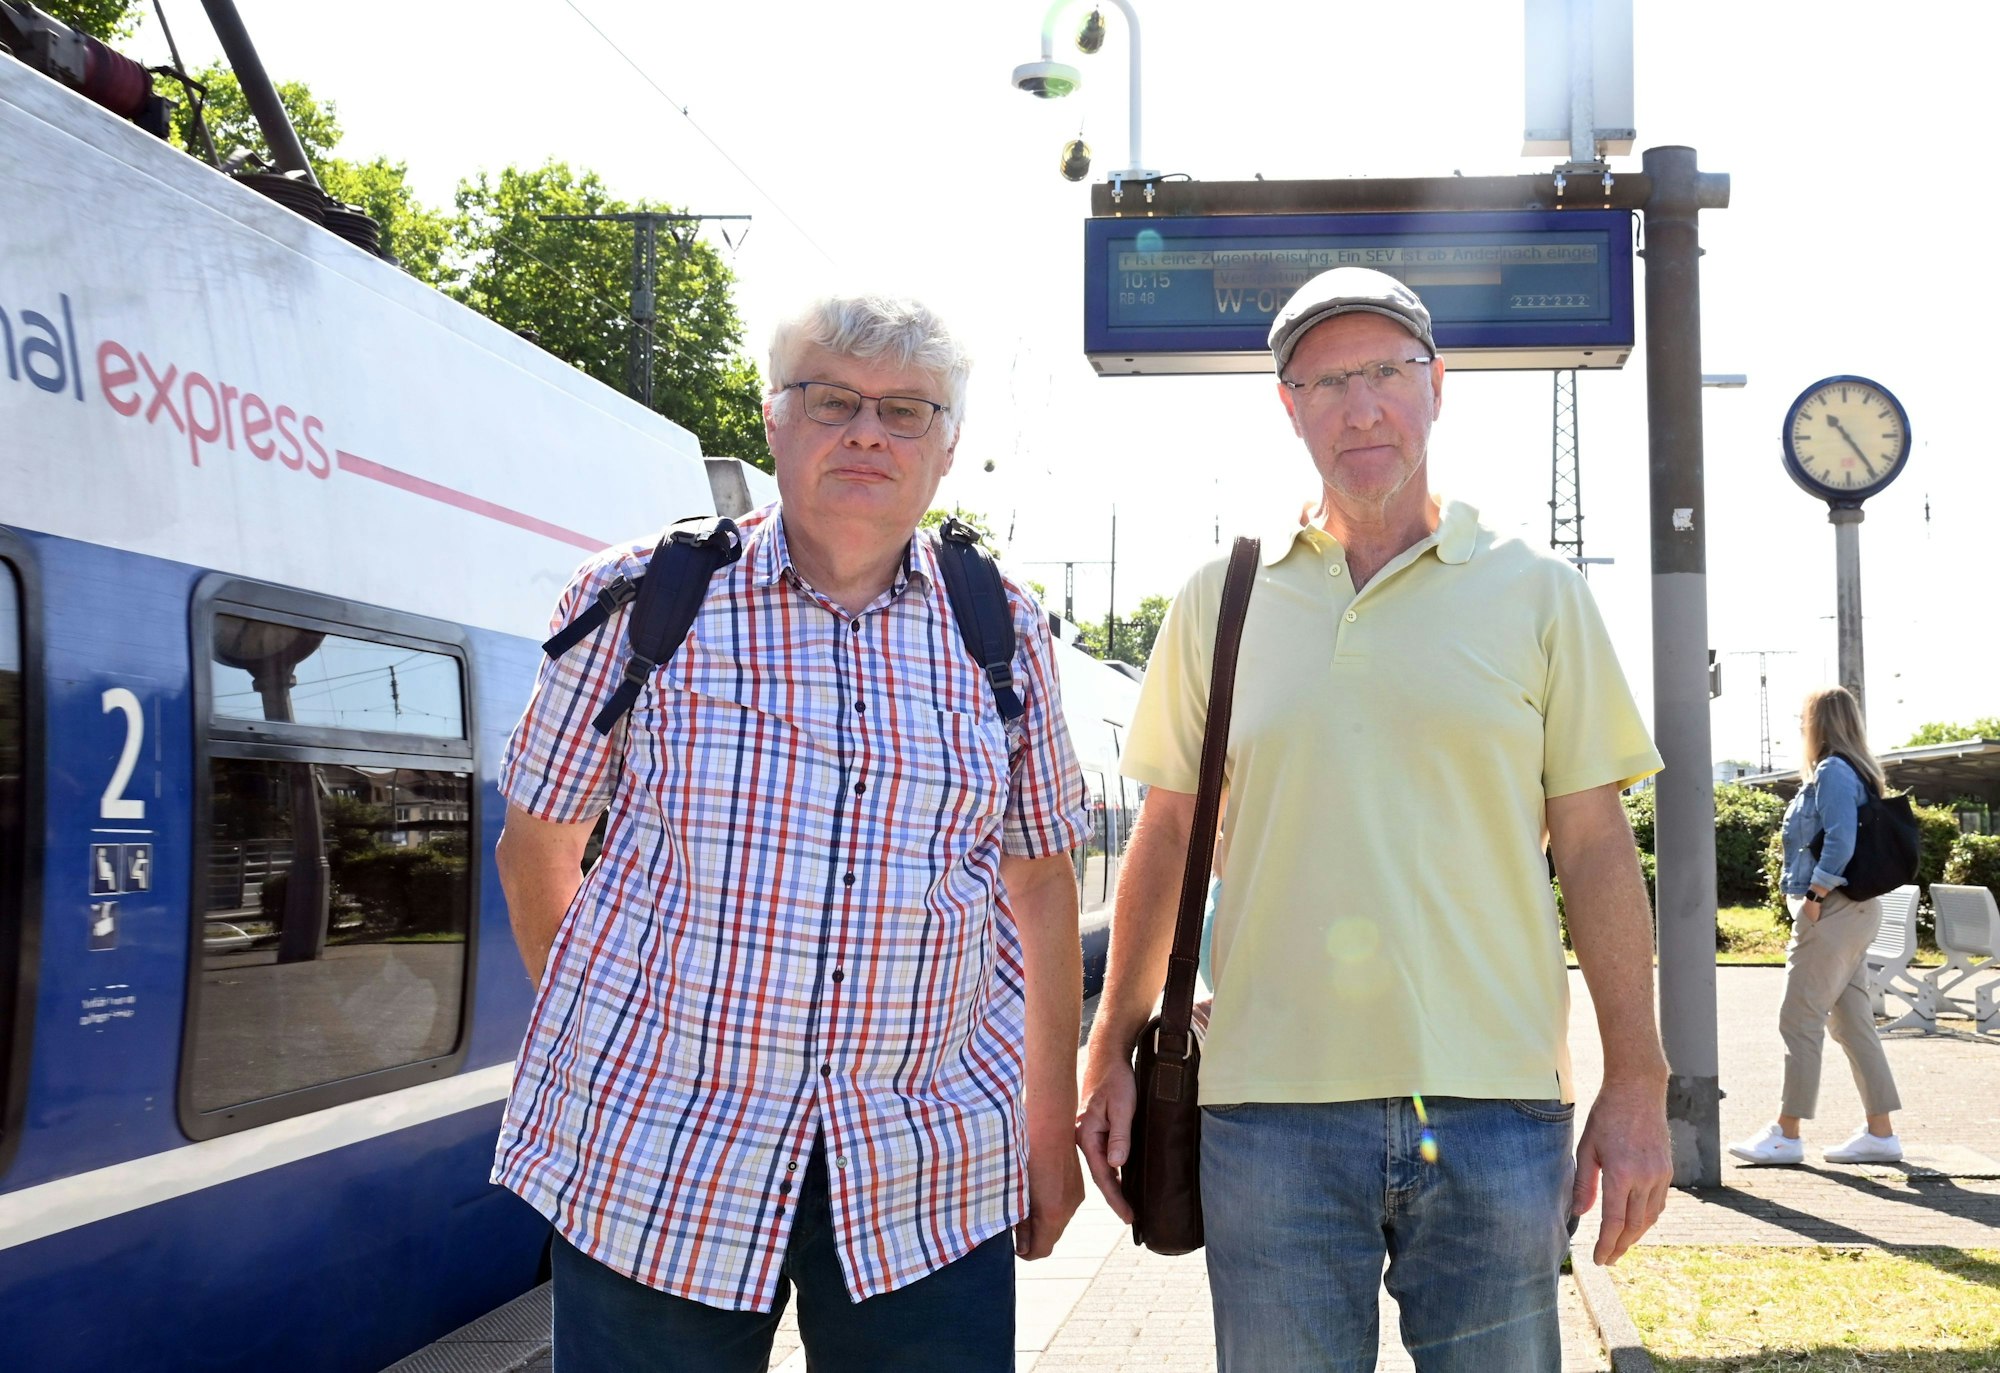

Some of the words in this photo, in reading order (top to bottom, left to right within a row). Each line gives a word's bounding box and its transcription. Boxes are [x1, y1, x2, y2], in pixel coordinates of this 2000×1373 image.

[1135, 253, 1155, 266] ist
[1160, 253, 1197, 265] eine
[1338, 249, 1361, 263] Ein
[1366, 249, 1395, 262] SEV
[1401, 248, 1421, 262] ist
[1427, 248, 1447, 261] ab
[1453, 247, 1541, 260] Andernach
[1121, 272, 1170, 289] 10:15
[1119, 292, 1136, 305] RB
[1139, 292, 1156, 305] 48
[1214, 287, 1289, 313] W-Ob
[96, 339, 331, 480] express
[101, 687, 145, 819] 2
